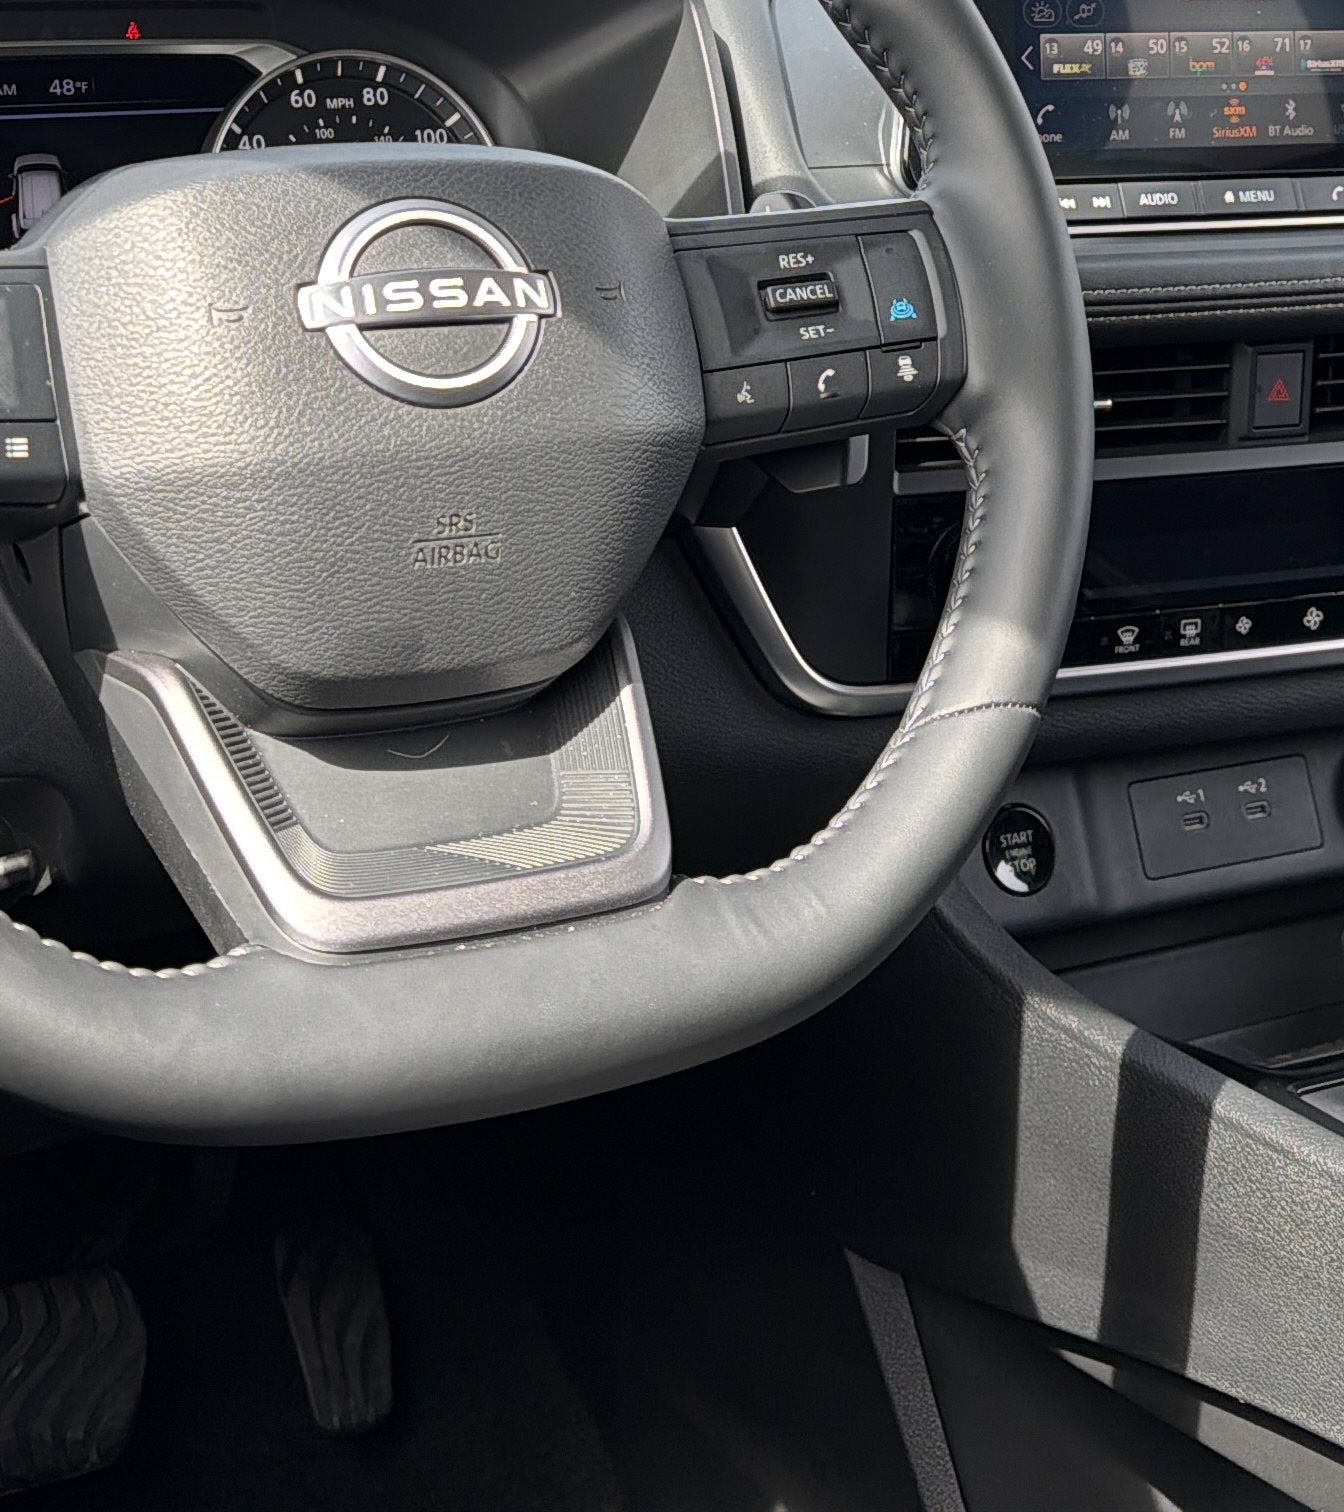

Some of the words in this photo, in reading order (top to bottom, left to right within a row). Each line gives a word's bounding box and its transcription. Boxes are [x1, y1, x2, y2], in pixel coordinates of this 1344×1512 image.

[1045, 42, 1058, 55] 13
[1083, 38, 1103, 55] 49
[1110, 41, 1124, 53] 14
[1148, 38, 1167, 54] 50
[1174, 41, 1188, 53] 15
[1212, 37, 1230, 54] 52
[1237, 40, 1250, 52] 16
[1274, 37, 1290, 52] 71
[1299, 39, 1312, 51] 17
[290, 89, 316, 109] 60
[325, 97, 355, 111] MPH
[362, 87, 389, 107] 80
[315, 128, 335, 139] 100
[414, 128, 448, 145] 100
[1039, 133, 1063, 142] one
[1109, 129, 1130, 140] AM
[1169, 128, 1186, 139] FM
[1212, 126, 1257, 138] SiriusXM
[1268, 125, 1281, 137] BT
[1283, 124, 1314, 136] Audio
[238, 134, 266, 150] 40
[1139, 192, 1179, 206] AUDIO
[1239, 189, 1275, 203] MENU
[778, 252, 815, 270] RES+
[312, 276, 551, 324] NISSAN
[775, 284, 834, 303] CANCEL
[799, 324, 835, 340] SET-
[435, 511, 476, 536] SRS
[412, 538, 502, 570] AIRBAG
[1114, 643, 1140, 654] FRONT
[1179, 636, 1201, 647] REAR
[1257, 777, 1267, 792] 2
[1197, 788, 1205, 802] 1
[999, 829, 1033, 848] START
[1008, 857, 1036, 876] TOP
